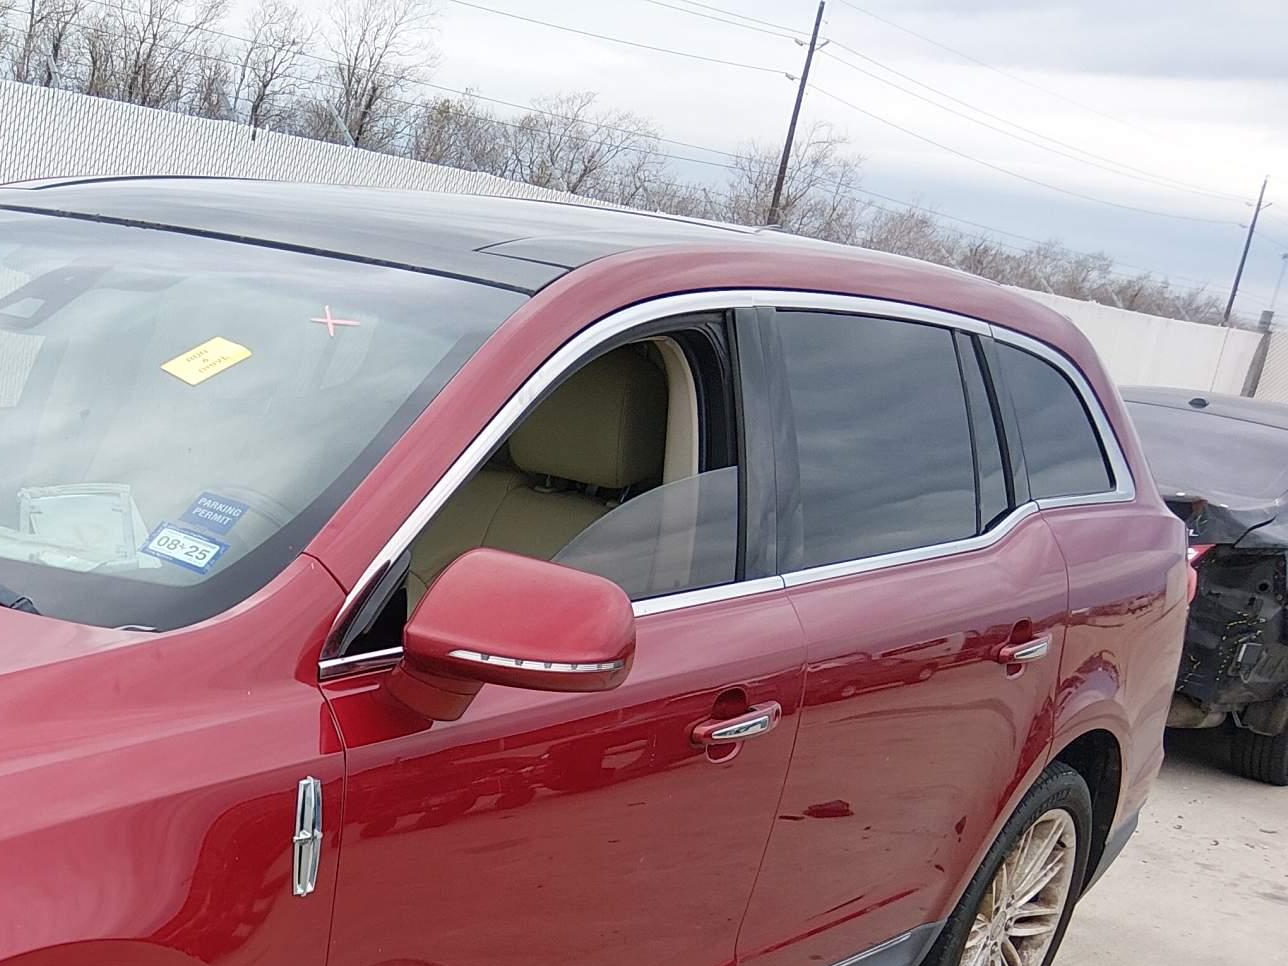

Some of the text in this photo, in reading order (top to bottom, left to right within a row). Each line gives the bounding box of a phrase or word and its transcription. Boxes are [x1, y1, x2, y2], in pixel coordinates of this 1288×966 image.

[192, 507, 233, 525] PERMIT
[197, 497, 242, 517] PARKING
[157, 535, 181, 551] 08
[184, 545, 211, 561] 25
